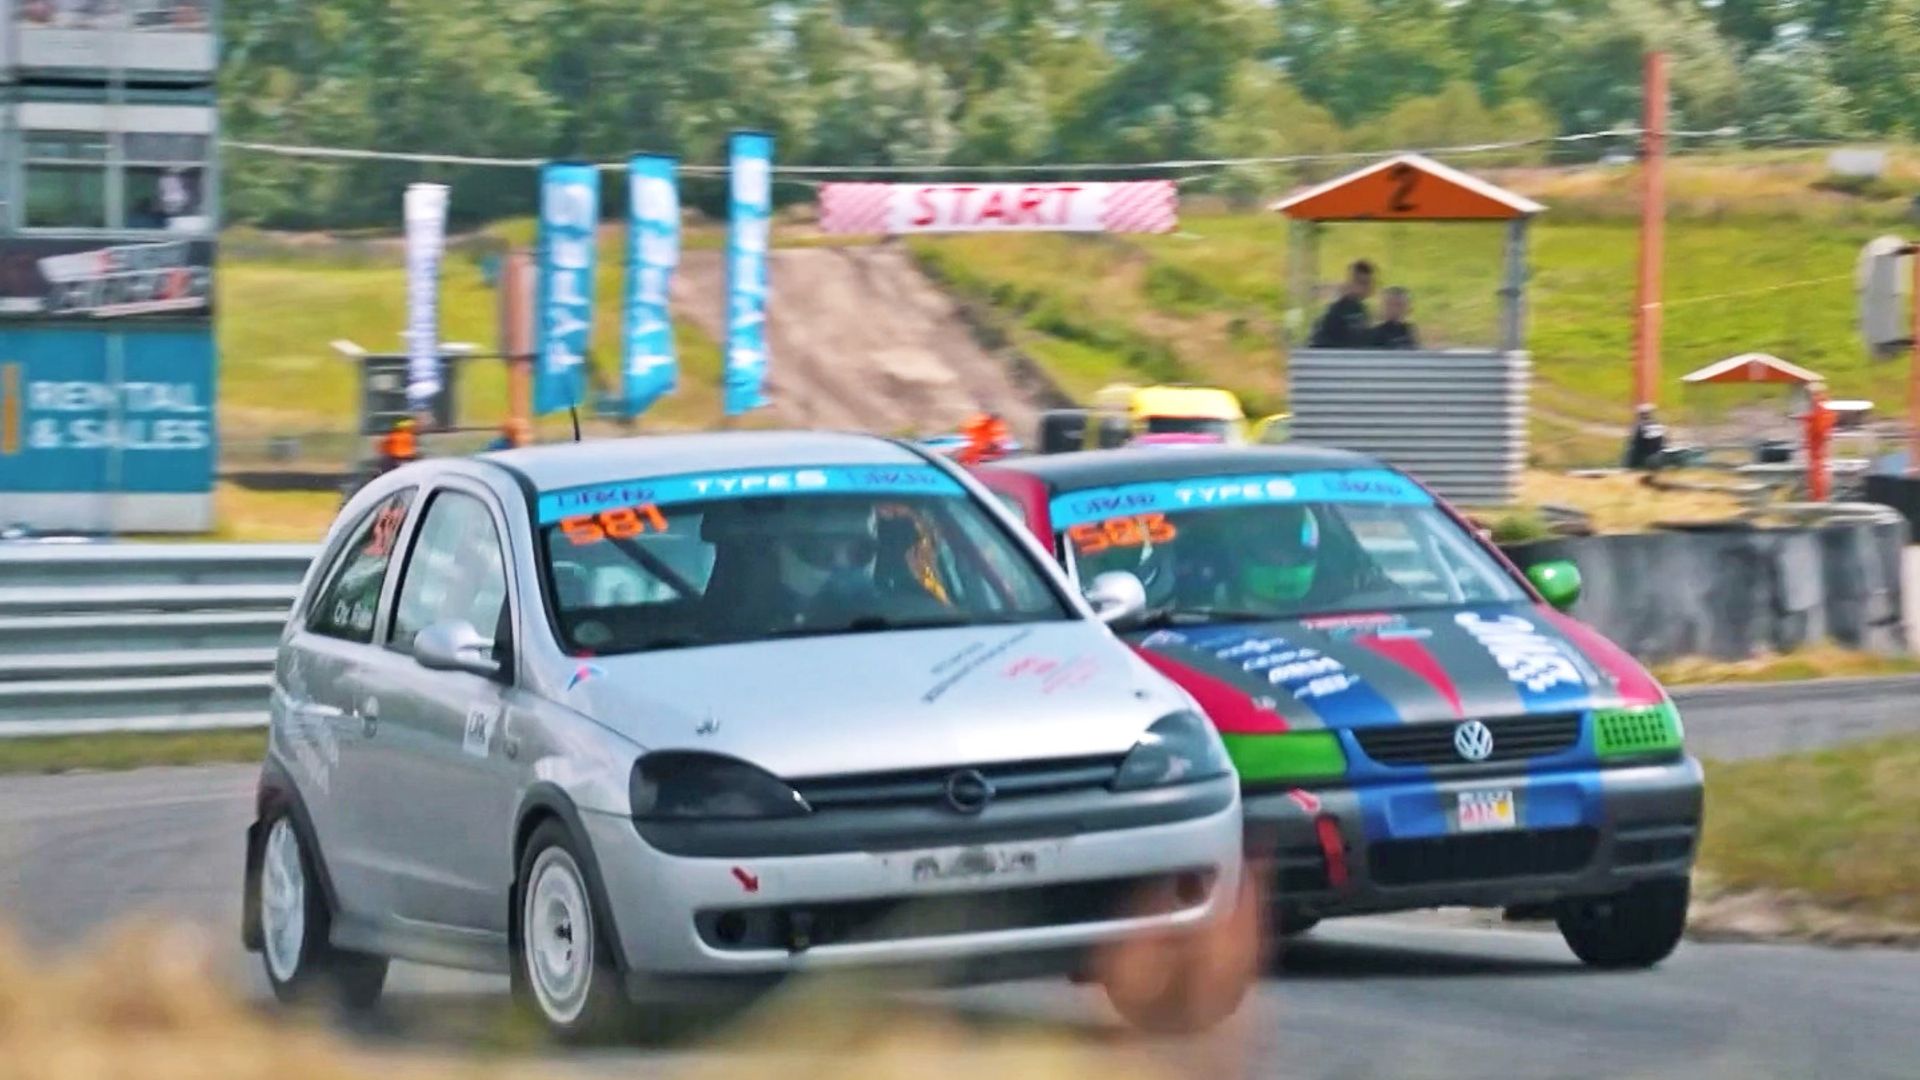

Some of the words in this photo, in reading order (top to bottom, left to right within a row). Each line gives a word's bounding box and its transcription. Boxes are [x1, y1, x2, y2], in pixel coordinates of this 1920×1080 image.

[912, 186, 1083, 226] START
[1388, 163, 1420, 212] 2
[28, 380, 208, 412] RENTAL
[28, 418, 62, 448] &
[68, 418, 210, 449] SALES
[560, 501, 669, 547] 581
